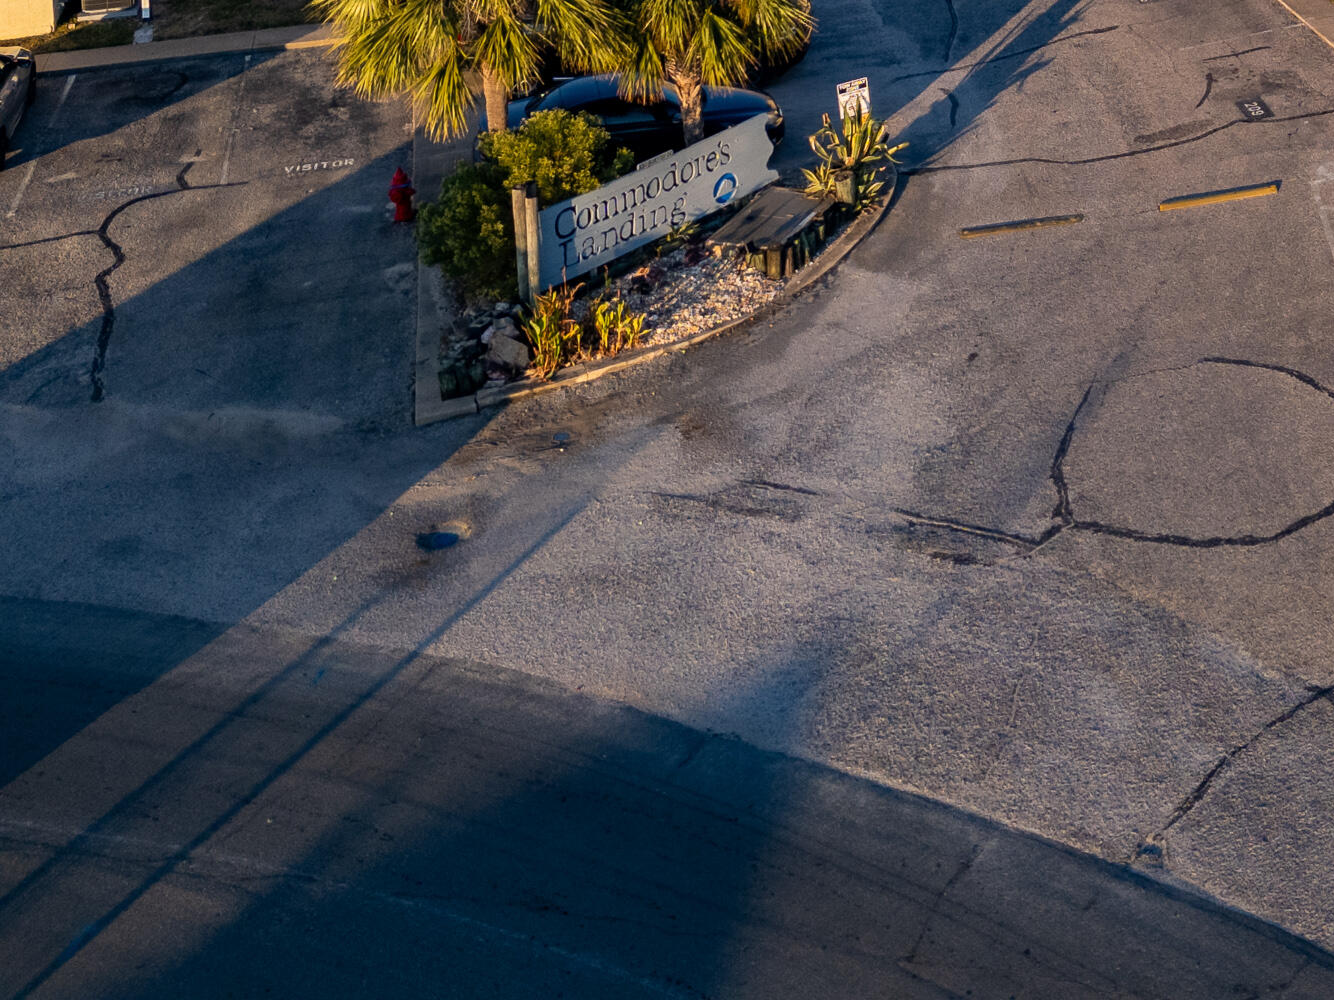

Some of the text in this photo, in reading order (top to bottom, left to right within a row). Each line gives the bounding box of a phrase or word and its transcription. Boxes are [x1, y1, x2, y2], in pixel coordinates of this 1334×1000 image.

[1244, 102, 1265, 116] 209
[284, 158, 355, 174] VISITOR
[554, 140, 731, 240] Commodore's
[558, 192, 688, 268] Landing
